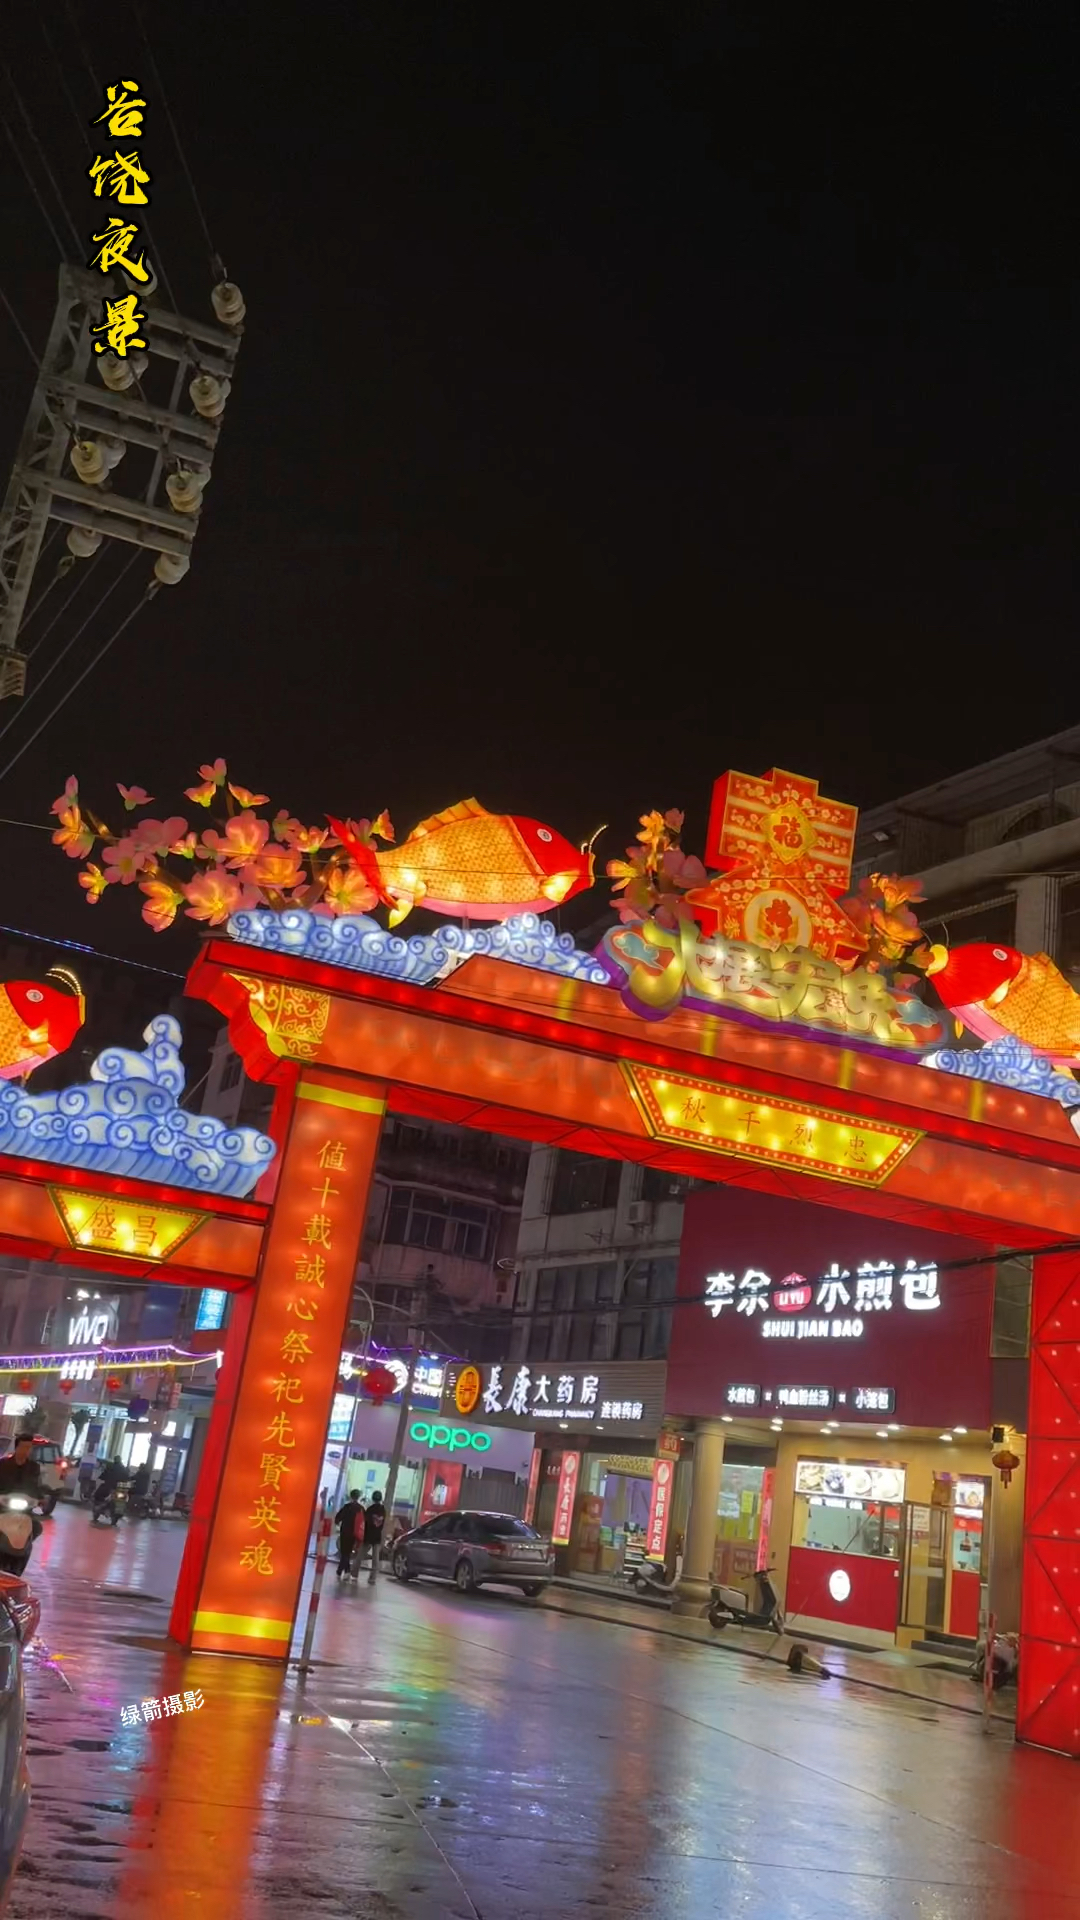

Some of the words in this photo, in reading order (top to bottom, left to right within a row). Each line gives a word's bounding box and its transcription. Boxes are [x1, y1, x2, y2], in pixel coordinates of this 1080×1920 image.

[704, 1270, 772, 1318] 李余
[816, 1259, 941, 1314] 水煎包
[68, 1304, 109, 1346] vivo
[762, 1320, 795, 1338] SHUI
[796, 1320, 829, 1339] JIAN
[831, 1318, 864, 1338] BAO
[727, 1387, 756, 1404] 水煎包
[855, 1391, 889, 1410] 小笼包
[409, 1422, 492, 1452] oppo
